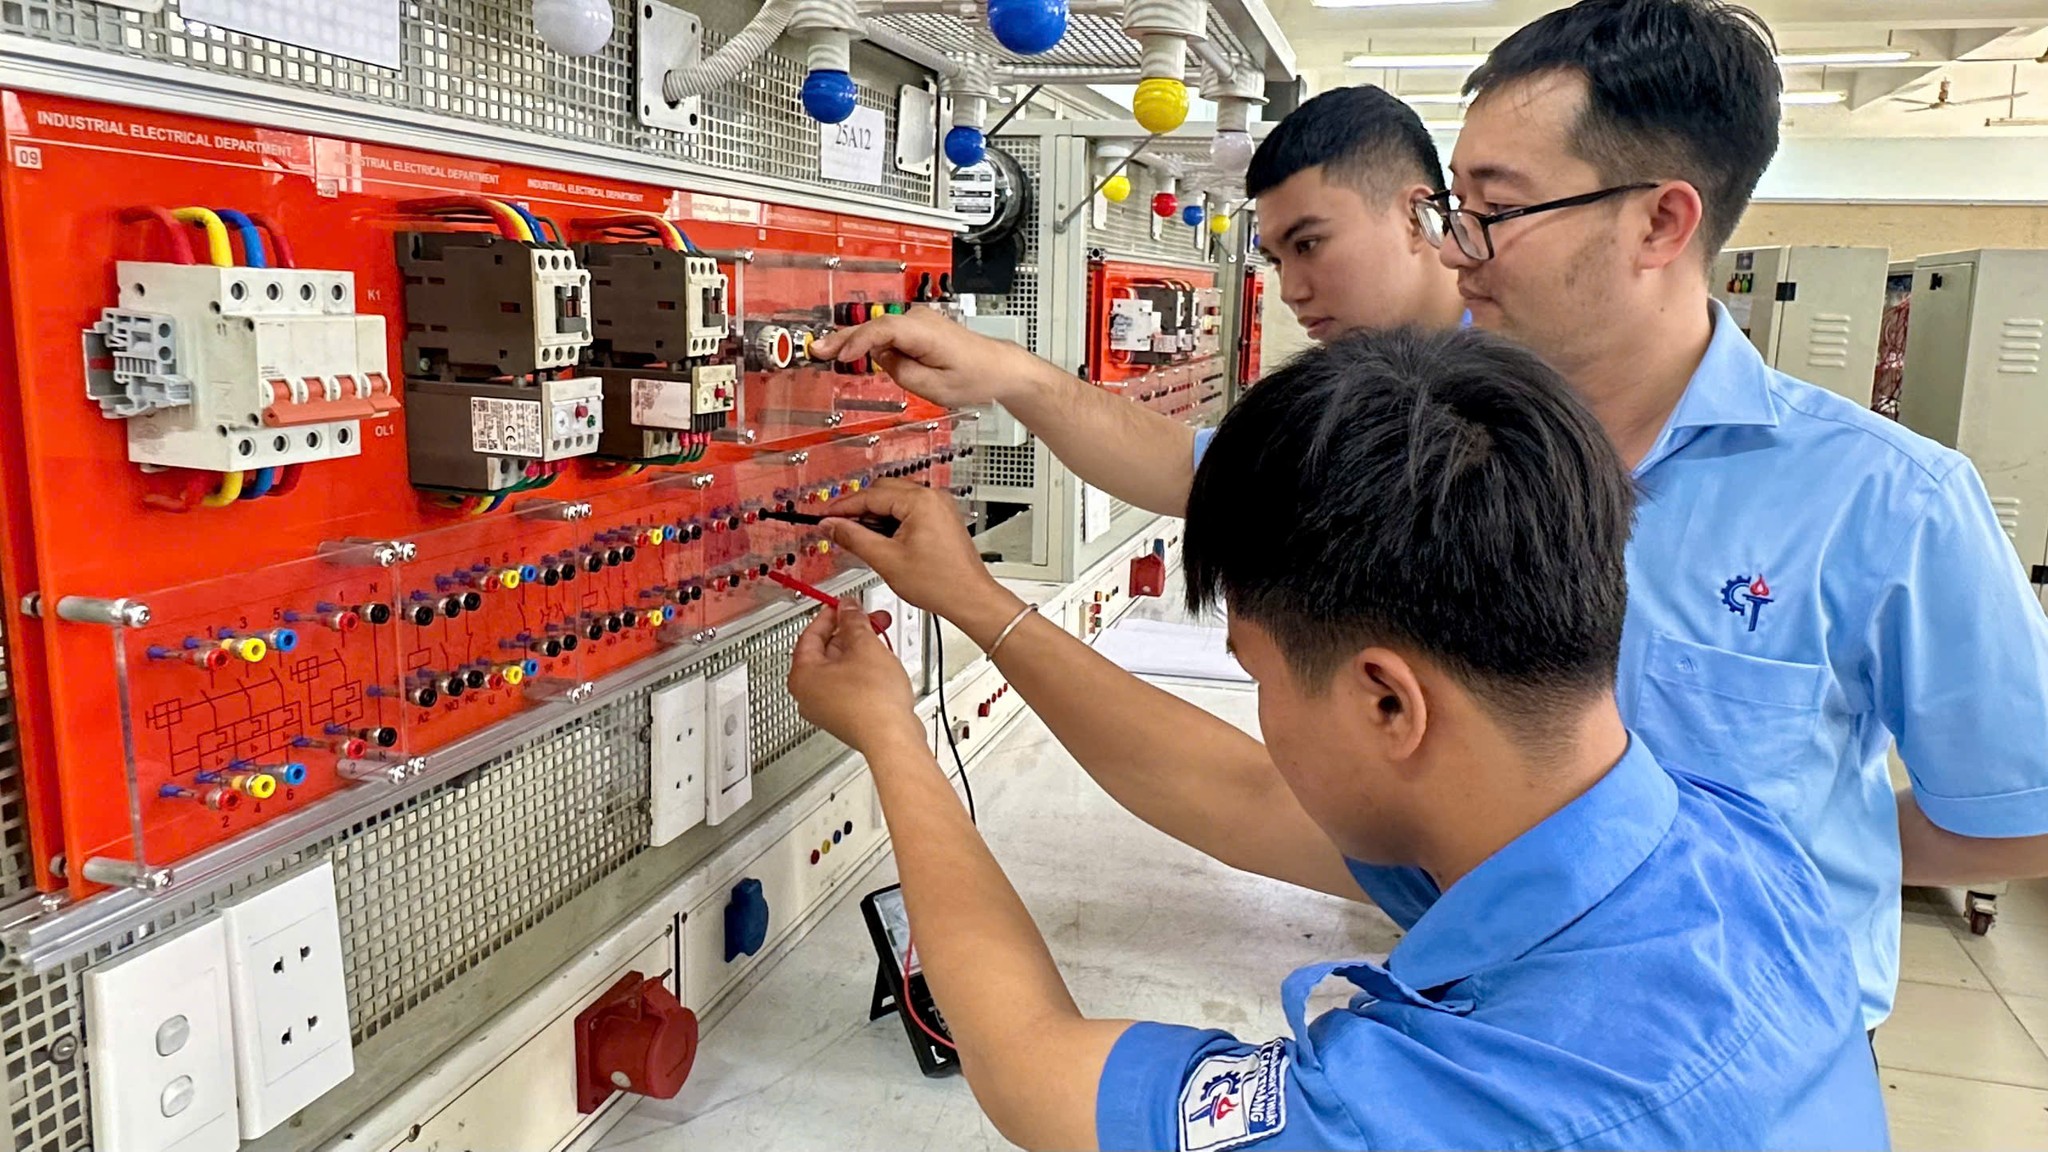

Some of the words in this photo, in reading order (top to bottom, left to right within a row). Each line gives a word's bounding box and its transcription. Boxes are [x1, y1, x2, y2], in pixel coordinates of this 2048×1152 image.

[38, 111, 127, 137] INDUSTRIAL
[131, 124, 212, 148] ELECTRICAL
[214, 135, 292, 158] DEPARTMENT
[835, 122, 871, 150] 25A12
[19, 149, 39, 165] 09
[393, 160, 446, 178] ELECTRICAL
[447, 167, 500, 185] DEPARTMENT
[367, 289, 381, 301] K1
[375, 425, 395, 438] OL1
[239, 617, 248, 629] 3
[273, 607, 281, 620] 5
[222, 815, 230, 828] 2
[253, 802, 261, 813] 4
[286, 788, 294, 800] 6
